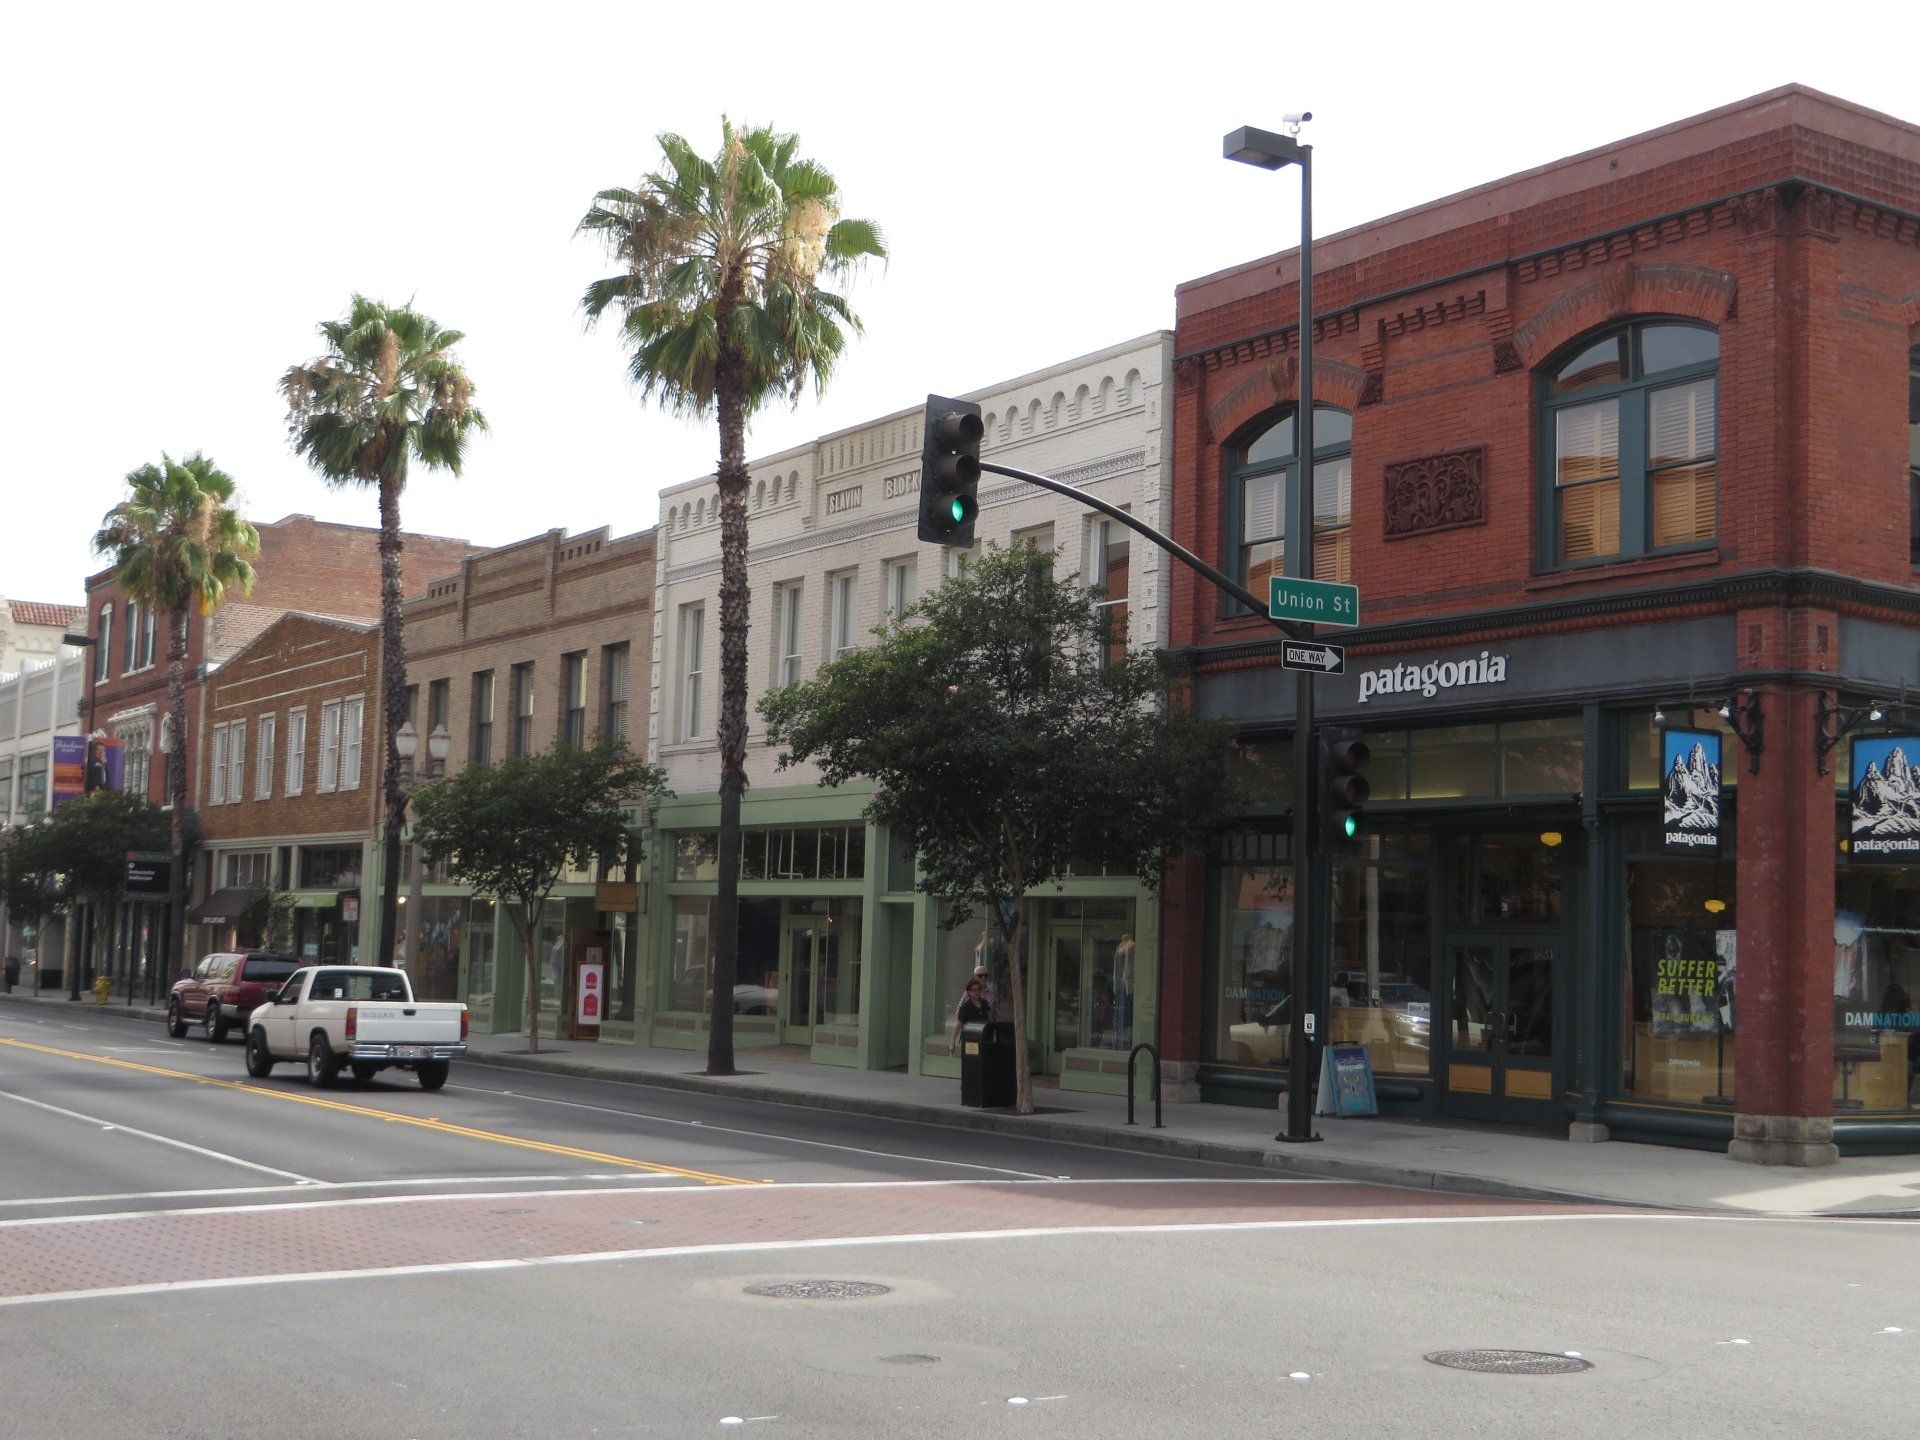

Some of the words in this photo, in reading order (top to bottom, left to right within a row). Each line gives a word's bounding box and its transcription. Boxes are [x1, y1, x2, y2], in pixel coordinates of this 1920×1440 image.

[829, 488, 861, 513] SLAVIN
[886, 471, 919, 499] BLOCK
[1278, 590, 1324, 610] Union
[1333, 597, 1351, 613] St
[1289, 650, 1306, 662] ONE
[1308, 652, 1326, 664] WAY
[1357, 650, 1507, 702] patagonia
[1665, 831, 1717, 846] patagonia
[1853, 838, 1919, 853] patagonia
[1657, 959, 1717, 978] SUFFER
[1657, 978, 1715, 996] BETTER
[1845, 1011, 1920, 1027] DAMNATION
